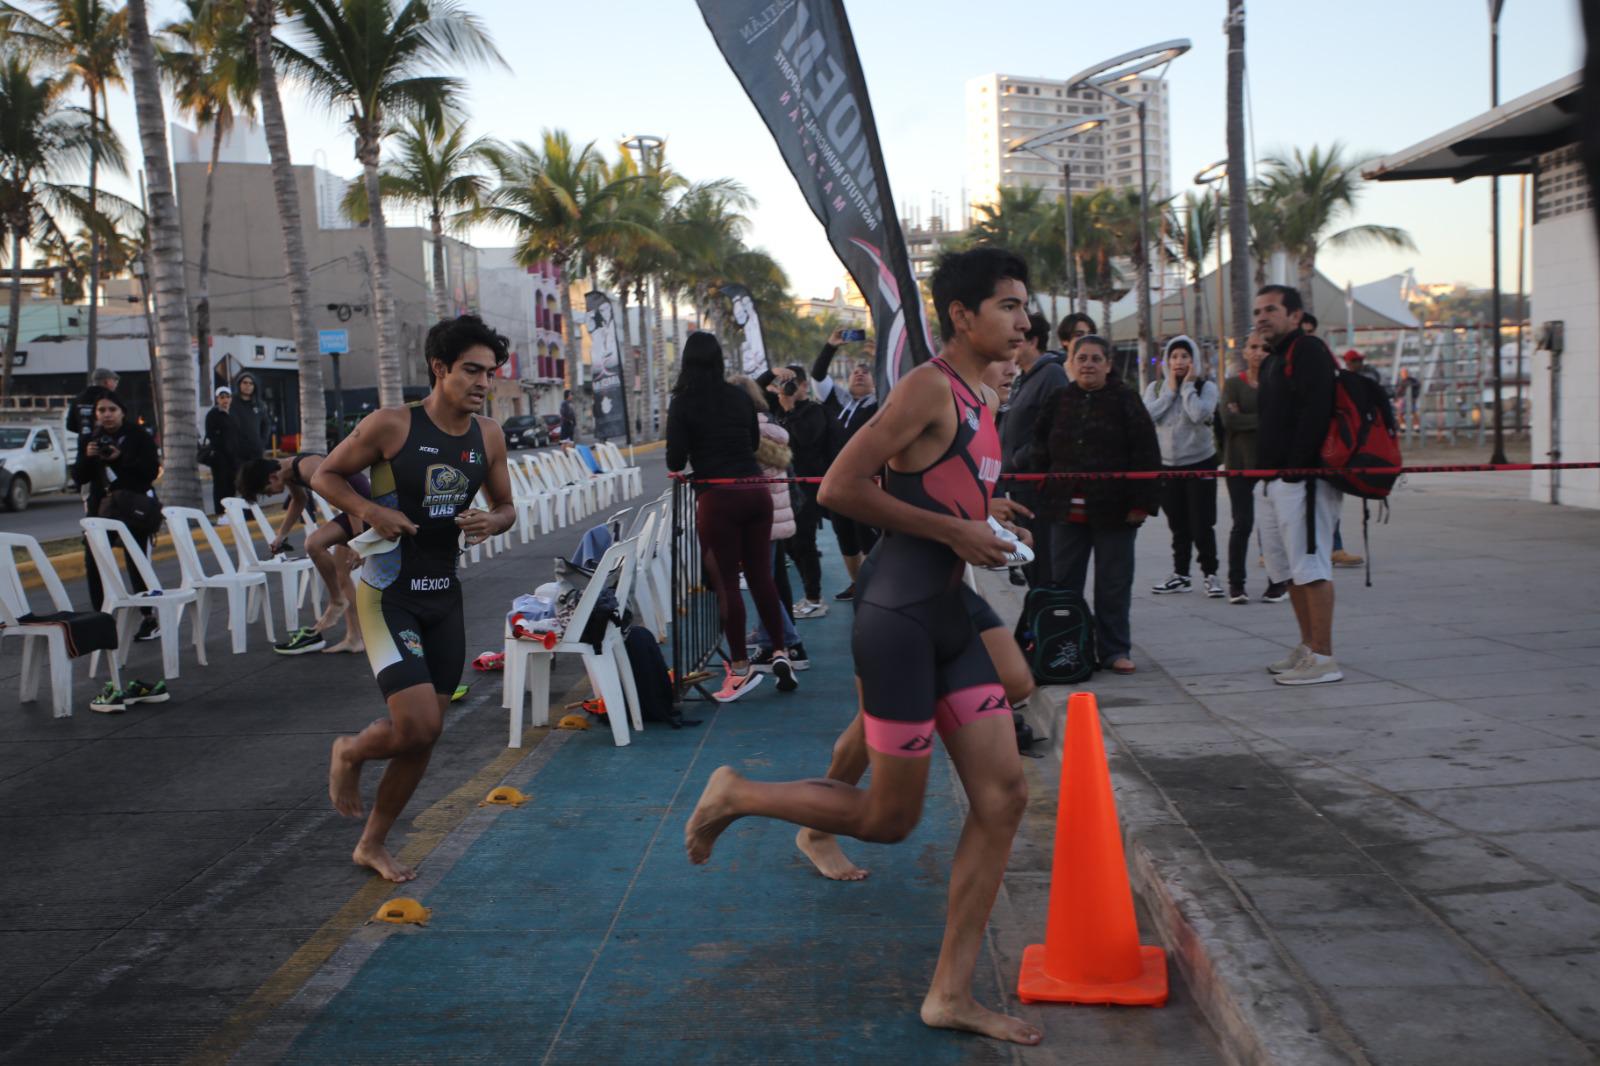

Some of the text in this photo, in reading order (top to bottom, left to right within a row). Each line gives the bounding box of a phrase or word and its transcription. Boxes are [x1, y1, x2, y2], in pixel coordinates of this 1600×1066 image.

[461, 449, 481, 464] MÉX
[430, 504, 455, 516] UAS
[411, 576, 450, 591] MÉXICO
